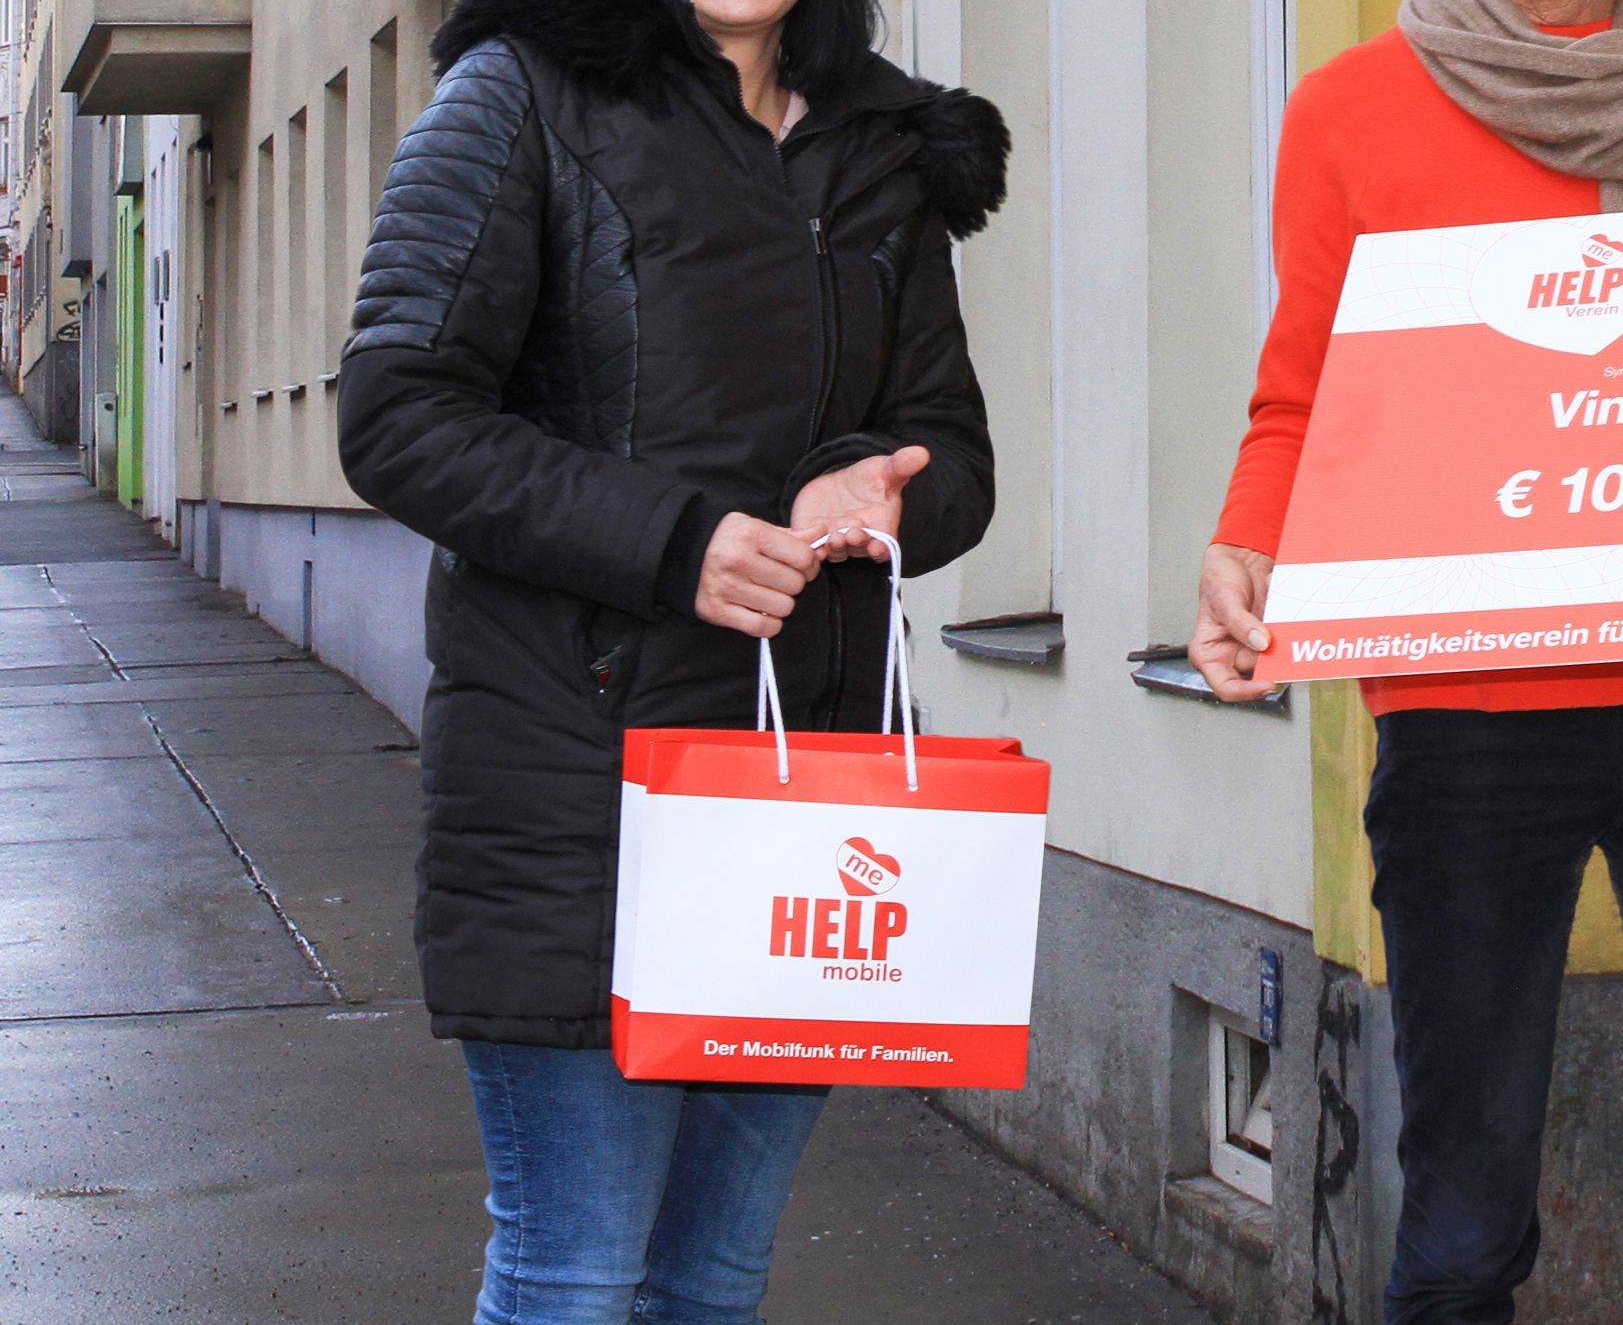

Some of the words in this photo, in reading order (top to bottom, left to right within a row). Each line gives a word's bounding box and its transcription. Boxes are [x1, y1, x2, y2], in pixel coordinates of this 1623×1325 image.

[1587, 242, 1613, 261] me
[1565, 303, 1620, 319] Verein
[1495, 469, 1542, 519] €
[1291, 623, 1590, 665] Wohltätigkeitsverein
[844, 851, 884, 886] me
[769, 896, 908, 962] HELP
[822, 962, 903, 983] mobile
[704, 1039, 738, 1057] Der
[742, 1040, 835, 1059] Mobilfunk
[839, 1042, 867, 1061] für
[871, 1044, 954, 1064] Familien.
